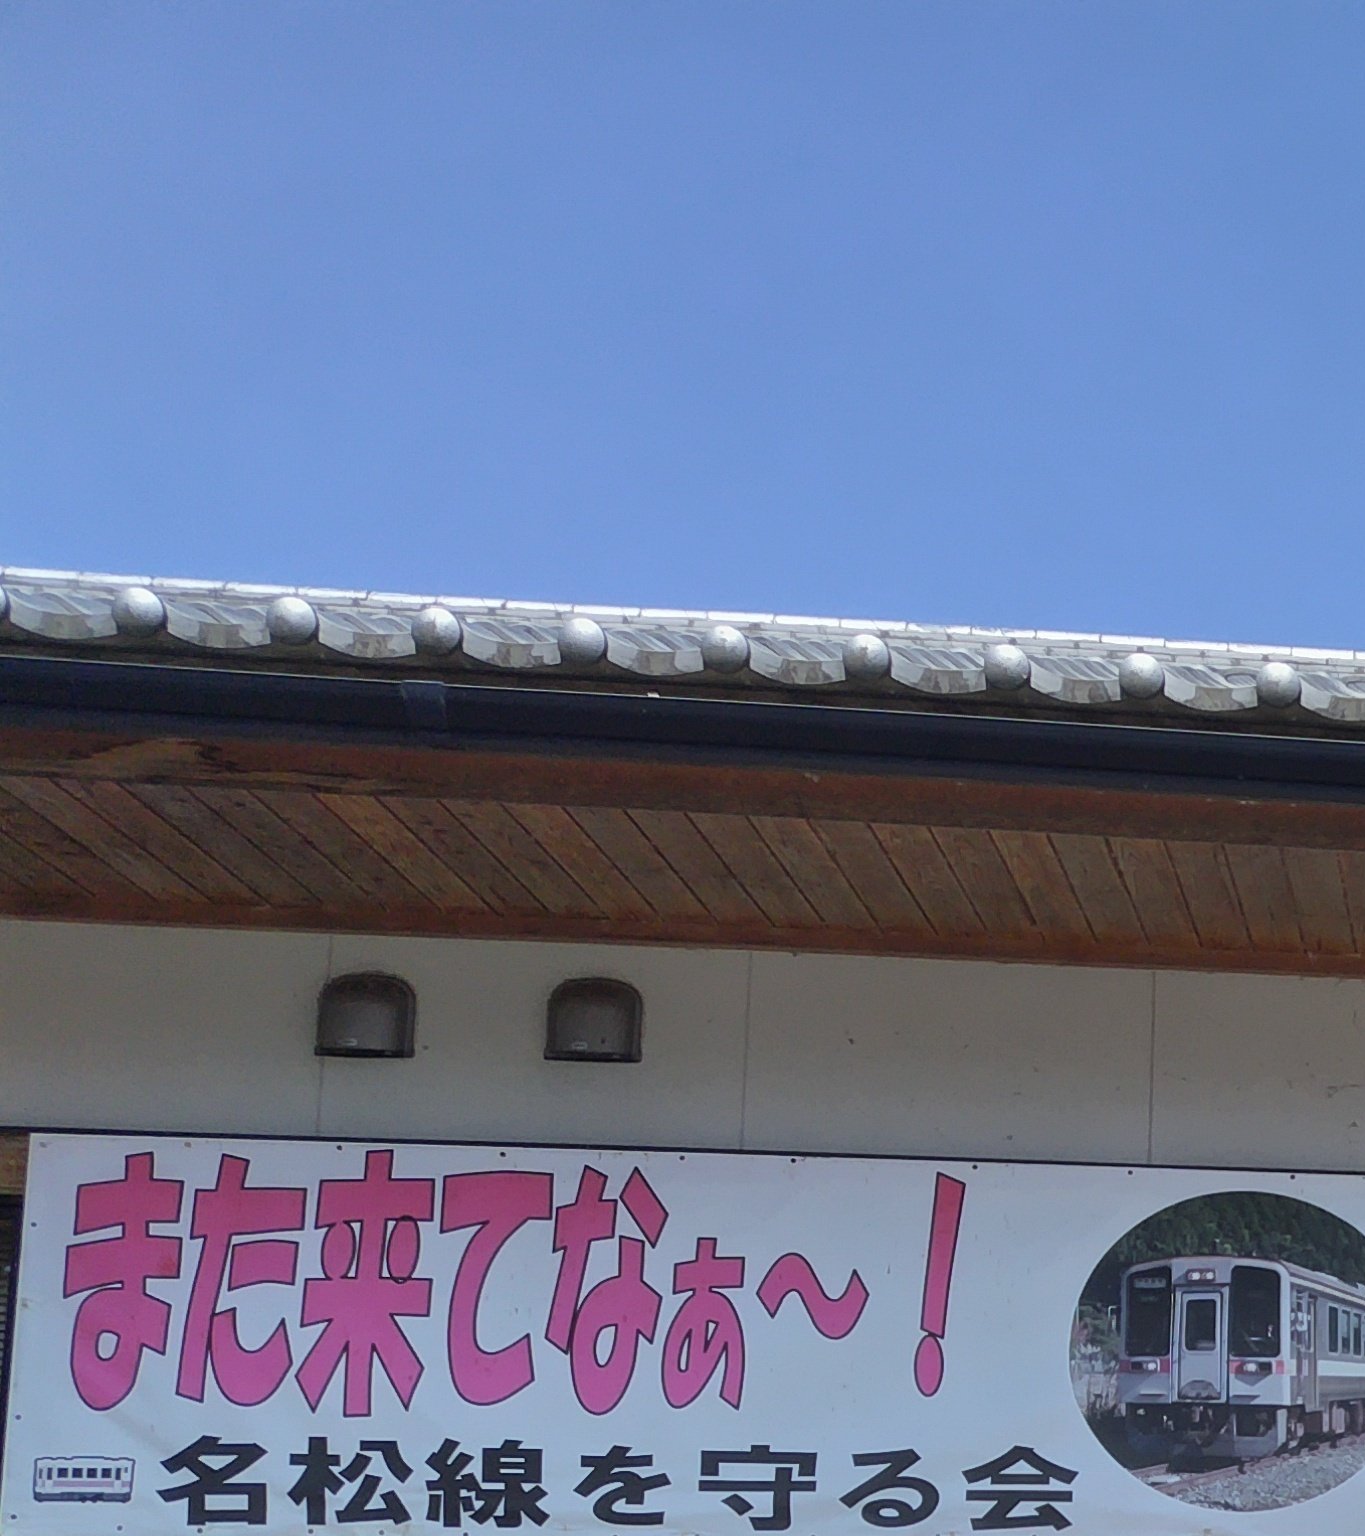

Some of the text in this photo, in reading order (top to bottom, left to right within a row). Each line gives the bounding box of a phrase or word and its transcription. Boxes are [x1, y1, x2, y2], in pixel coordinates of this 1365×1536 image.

[159, 1434, 1080, 1532] 名松線を守る会
